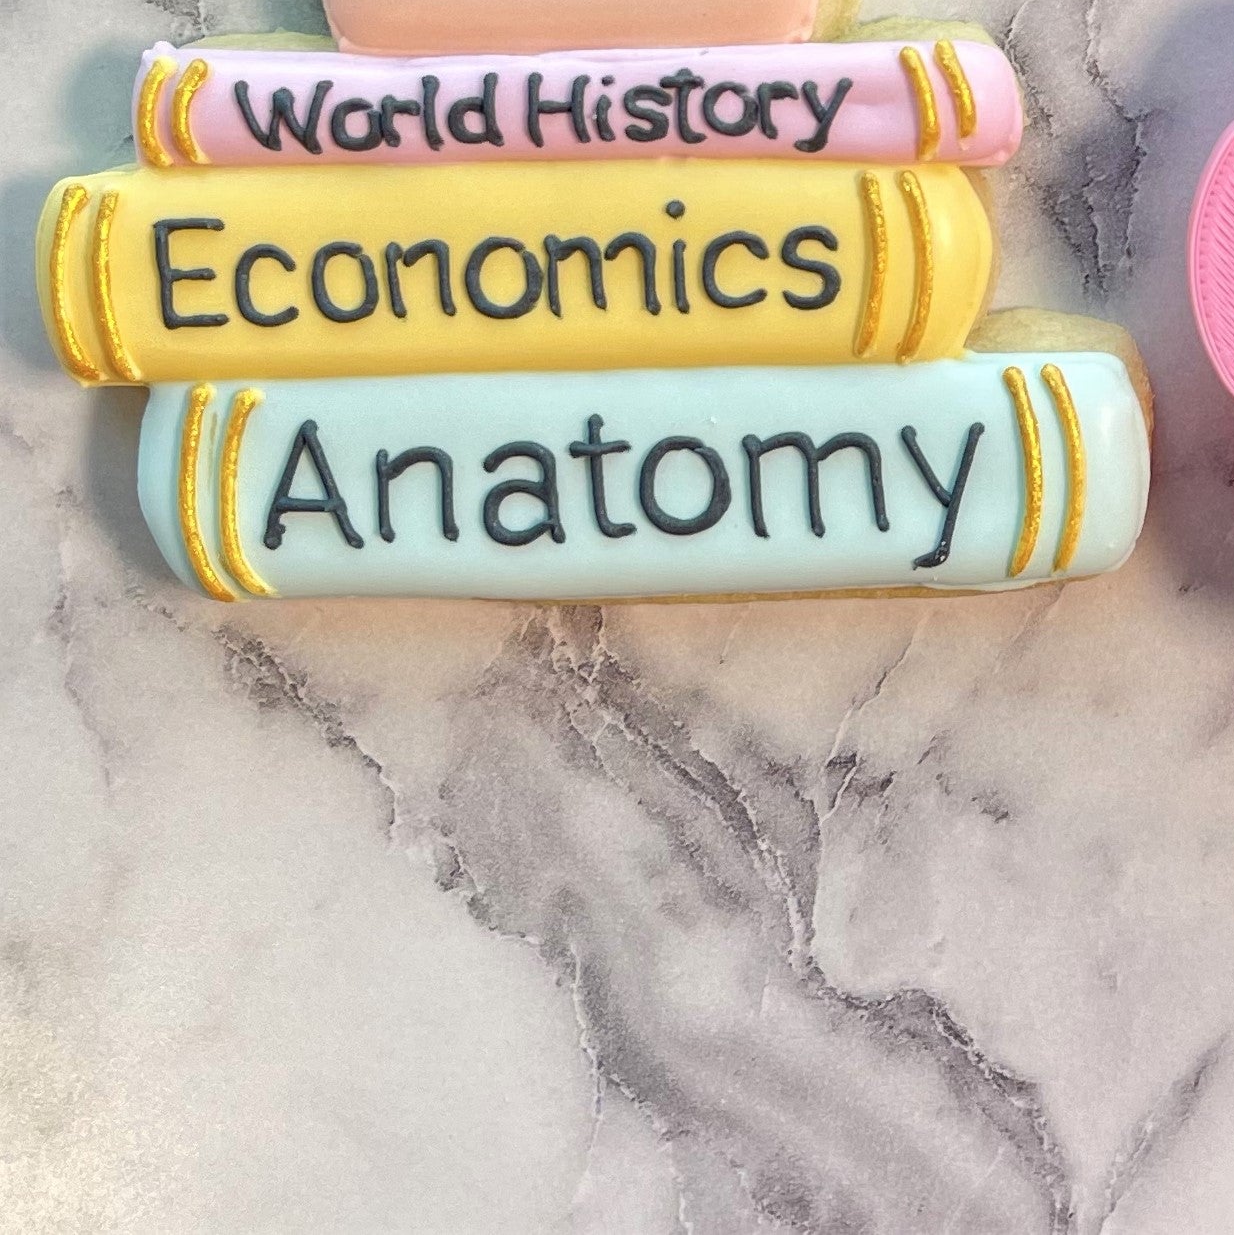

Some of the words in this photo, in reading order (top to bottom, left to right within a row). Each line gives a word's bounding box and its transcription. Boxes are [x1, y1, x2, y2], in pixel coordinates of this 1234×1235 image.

[233, 72, 505, 156] World
[526, 68, 854, 153] History
[152, 199, 842, 331] Economics
[262, 412, 986, 570] Anatomy
